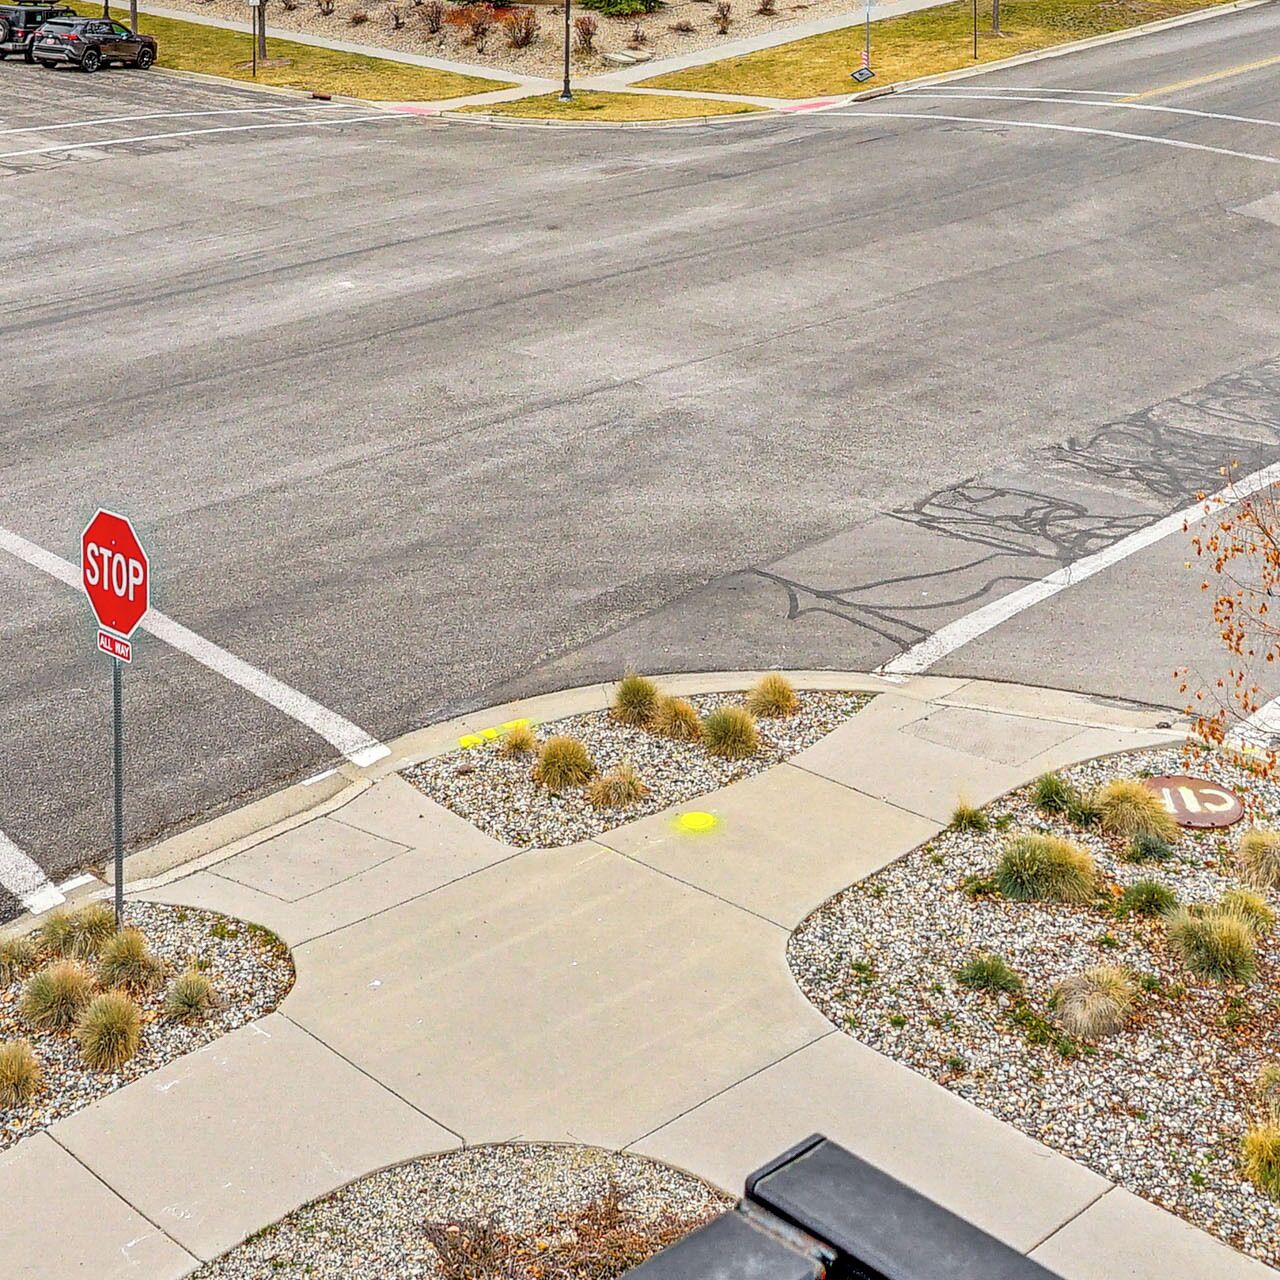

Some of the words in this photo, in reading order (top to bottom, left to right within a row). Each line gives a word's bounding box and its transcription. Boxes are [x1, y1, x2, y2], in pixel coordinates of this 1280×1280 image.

[86, 542, 144, 601] STOP
[99, 635, 113, 650] ALL
[115, 642, 129, 657] WAY
